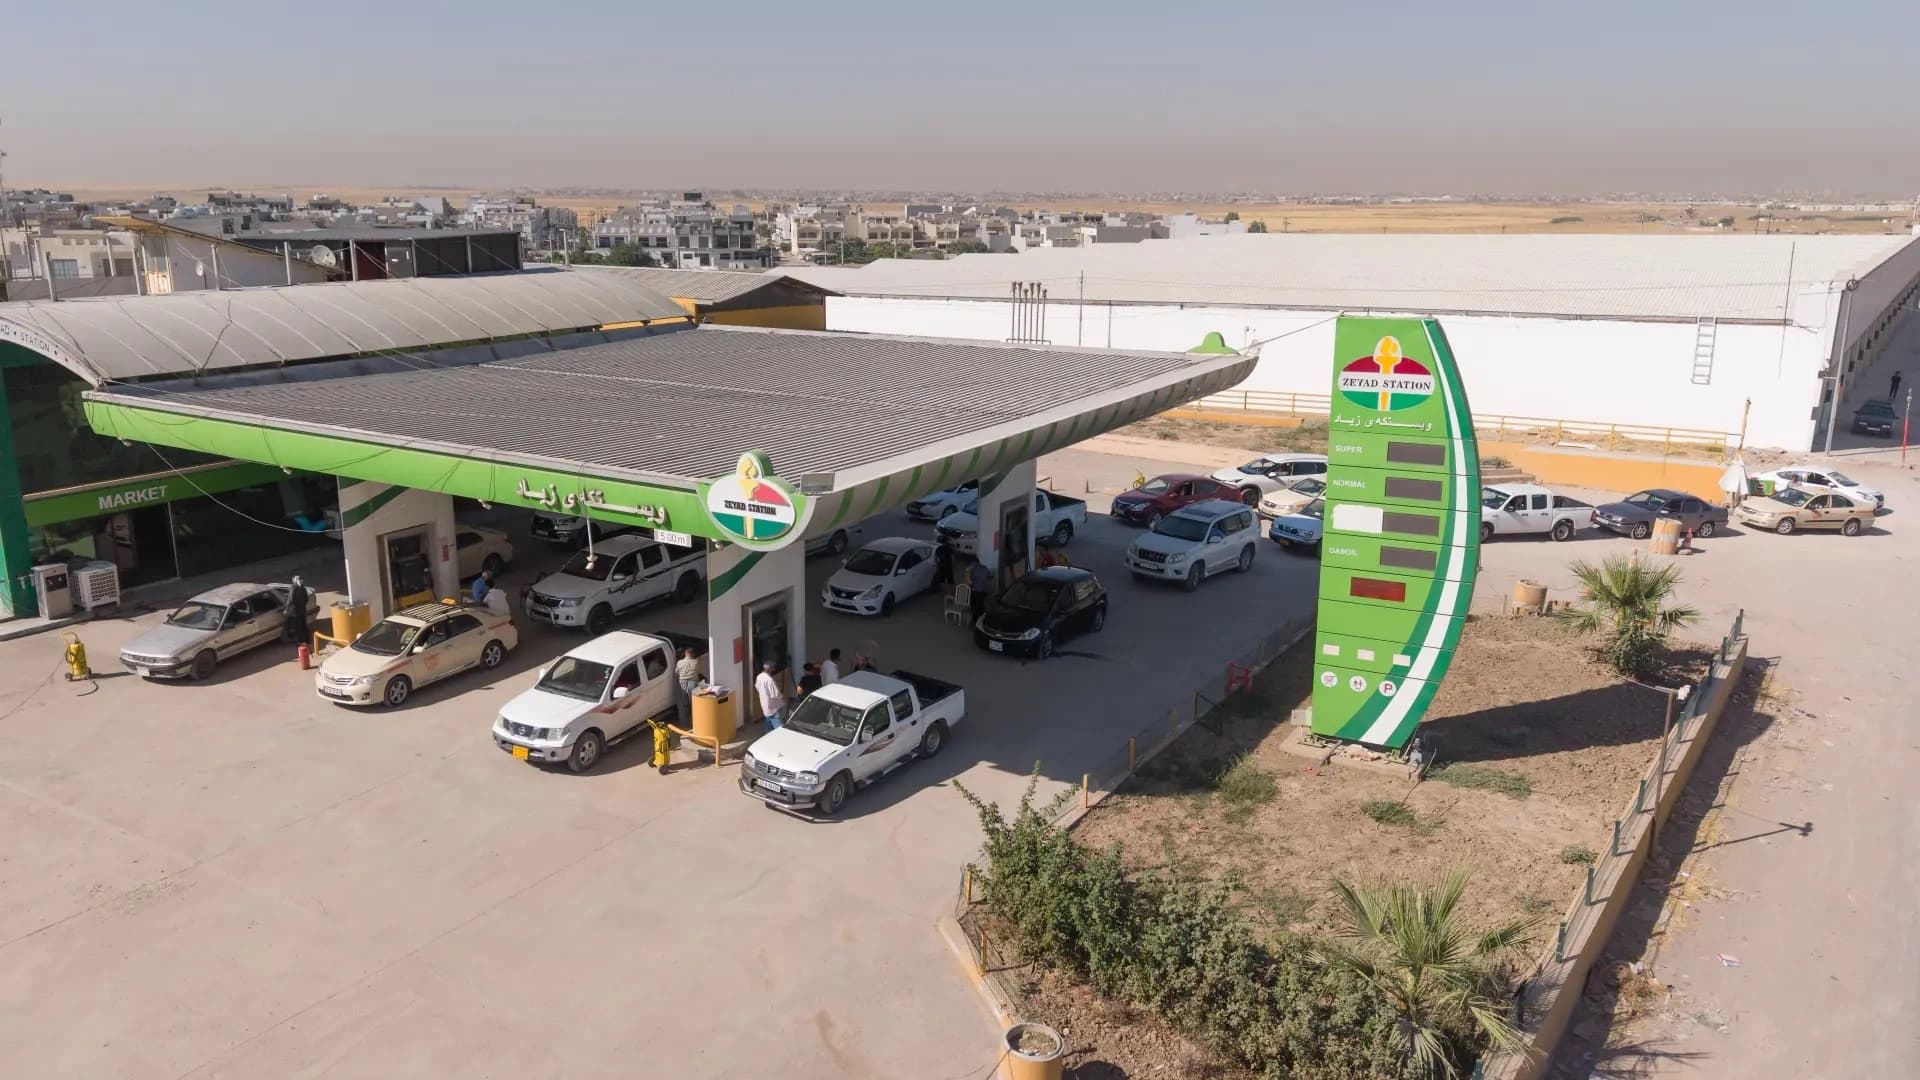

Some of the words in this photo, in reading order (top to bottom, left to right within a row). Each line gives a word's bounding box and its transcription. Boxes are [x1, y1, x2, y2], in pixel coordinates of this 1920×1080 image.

[1342, 377, 1379, 387] ZEYAD
[1383, 379, 1431, 390] STATION
[1335, 444, 1362, 453] SUPER
[1333, 479, 1365, 488] NORMAL
[98, 485, 168, 510] MARKET
[724, 499, 746, 511] ZEYAD
[747, 503, 776, 516] STATION
[1329, 547, 1358, 556] GASOIL
[1384, 683, 1393, 693] P
